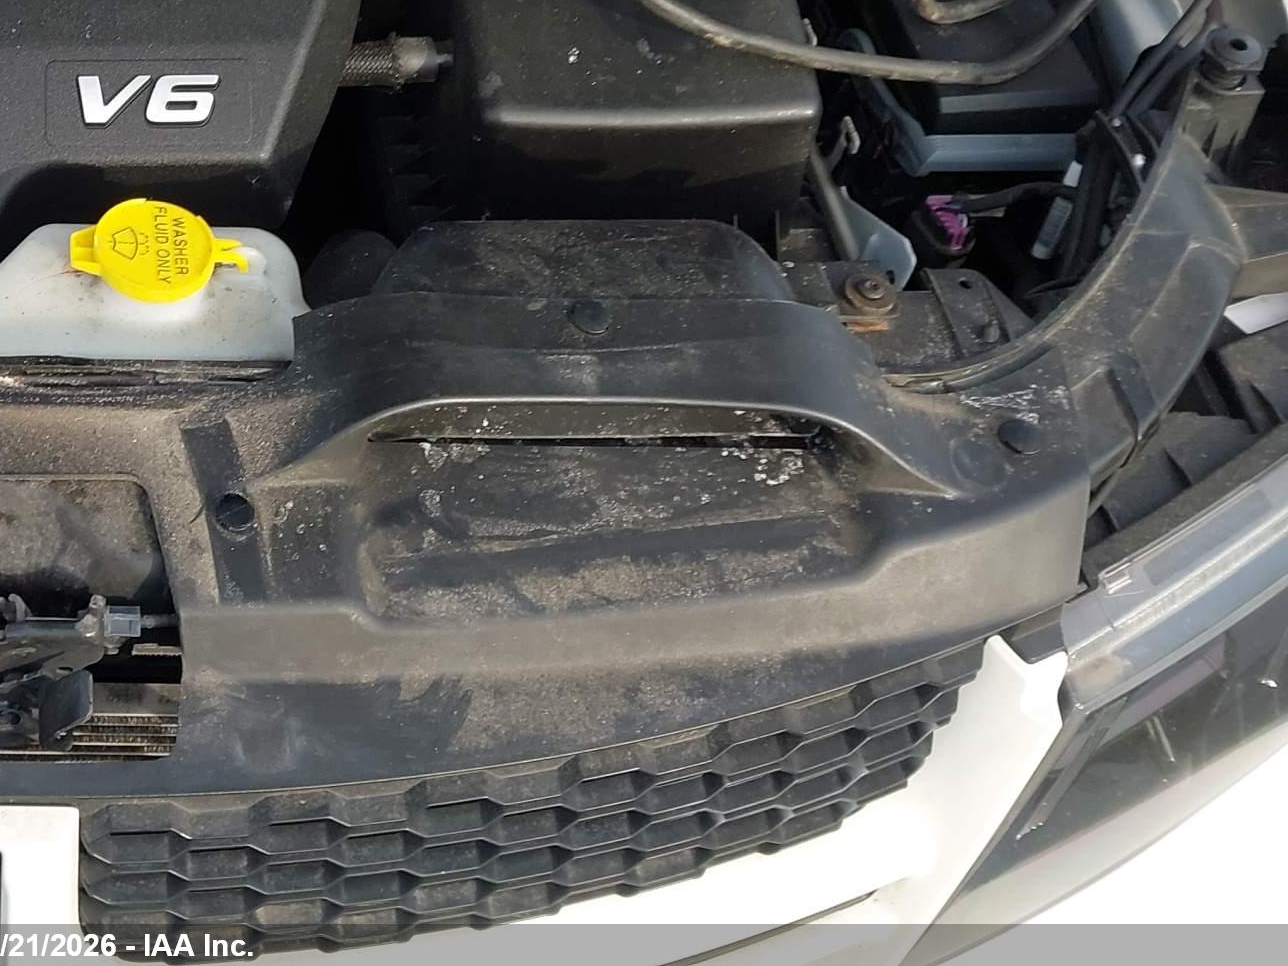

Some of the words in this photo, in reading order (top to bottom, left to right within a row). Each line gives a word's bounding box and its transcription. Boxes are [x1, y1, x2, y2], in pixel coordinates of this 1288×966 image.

[77, 74, 221, 126] V6
[154, 206, 169, 243] FLUID
[172, 217, 189, 275] WASHER
[156, 249, 171, 284] ONLY
